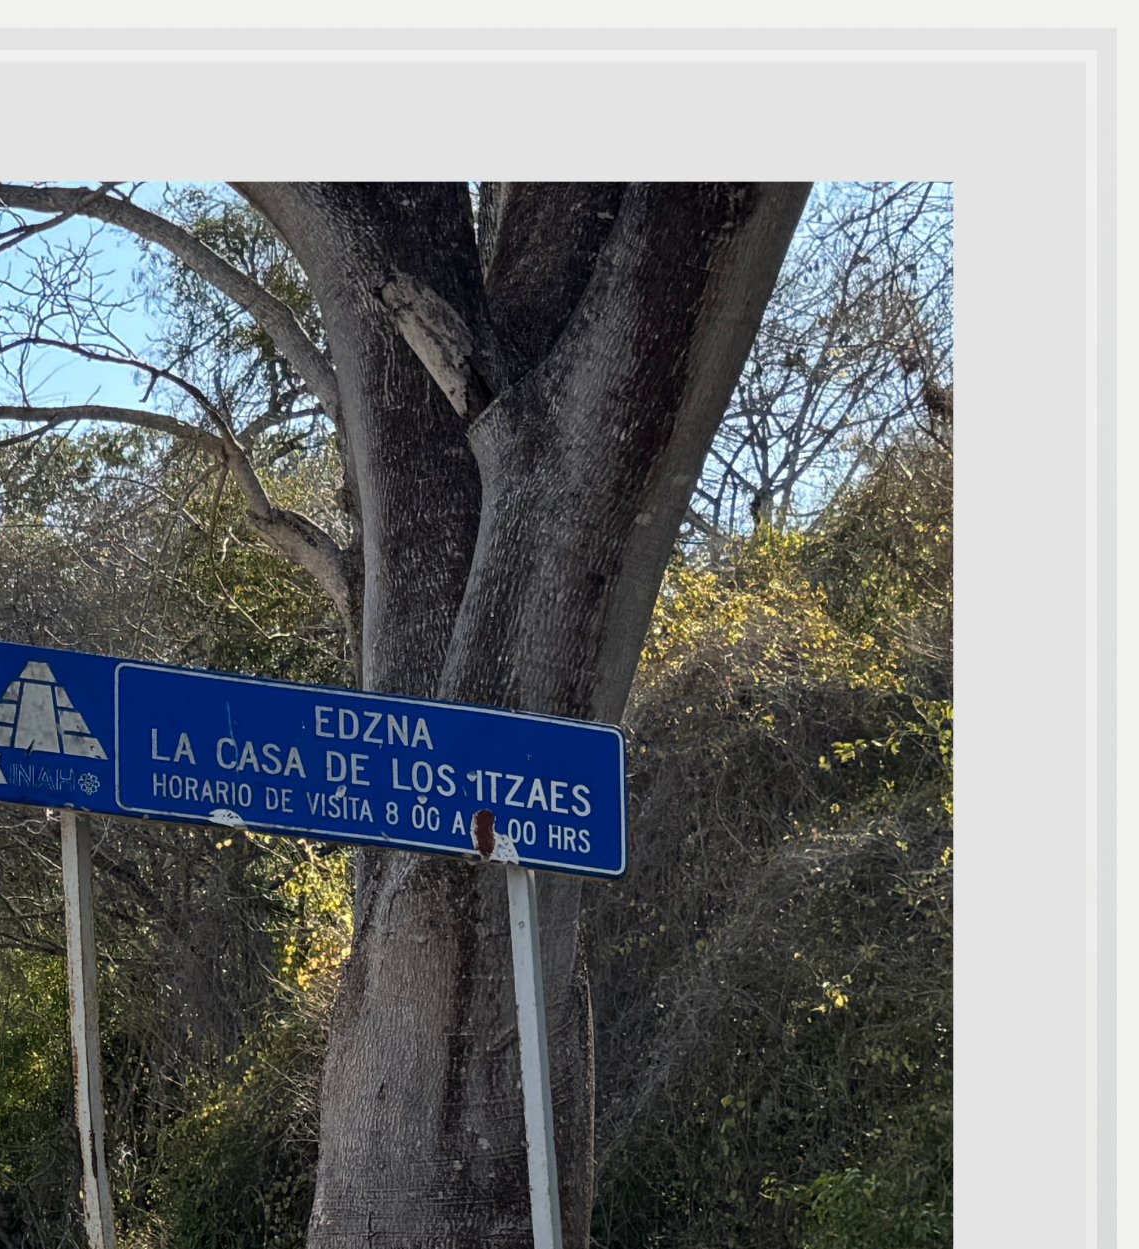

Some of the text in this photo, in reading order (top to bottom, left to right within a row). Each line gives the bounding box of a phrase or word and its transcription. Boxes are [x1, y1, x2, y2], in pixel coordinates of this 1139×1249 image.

[315, 705, 433, 750] EDZNA
[10, 763, 76, 791] INAH
[151, 728, 591, 817] LA CASA DE LOS ITZAES
[153, 772, 252, 807] HORARIO
[265, 786, 293, 813] DE
[306, 792, 374, 822] VISITA
[452, 811, 466, 836] A
[548, 824, 591, 854] HRS
